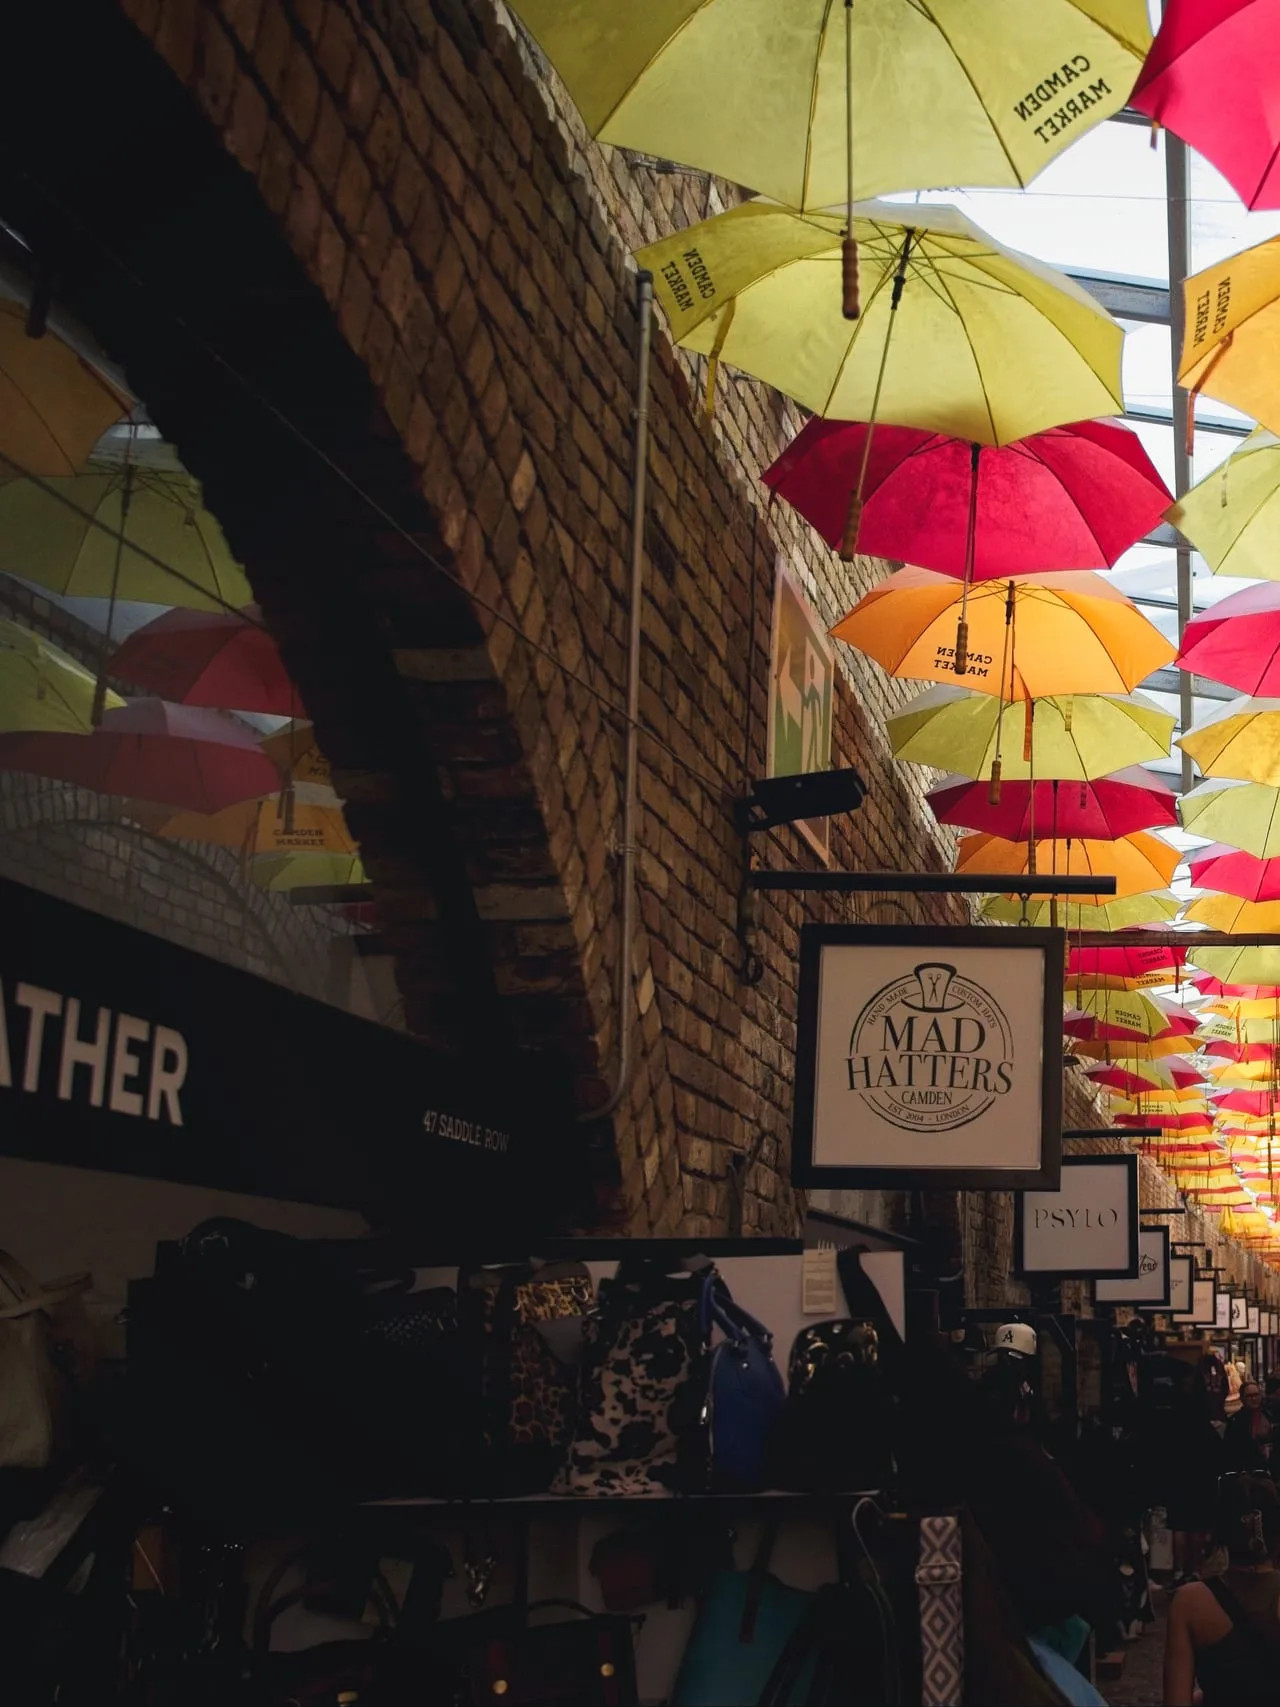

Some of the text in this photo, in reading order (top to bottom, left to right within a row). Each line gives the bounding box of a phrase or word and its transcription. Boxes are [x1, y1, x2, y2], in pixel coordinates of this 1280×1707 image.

[867, 986, 998, 1029] HAND MADE CUSTOM HATS
[879, 1015, 986, 1053] MAD
[844, 1055, 1014, 1094] HATTERS
[888, 1103, 904, 1116] EST
[936, 1104, 970, 1122] LONDON
[901, 1091, 952, 1105] CAMDEN
[424, 1110, 510, 1152] 47 SADDLE ROW
[1035, 1208, 1118, 1228] PSYLO
